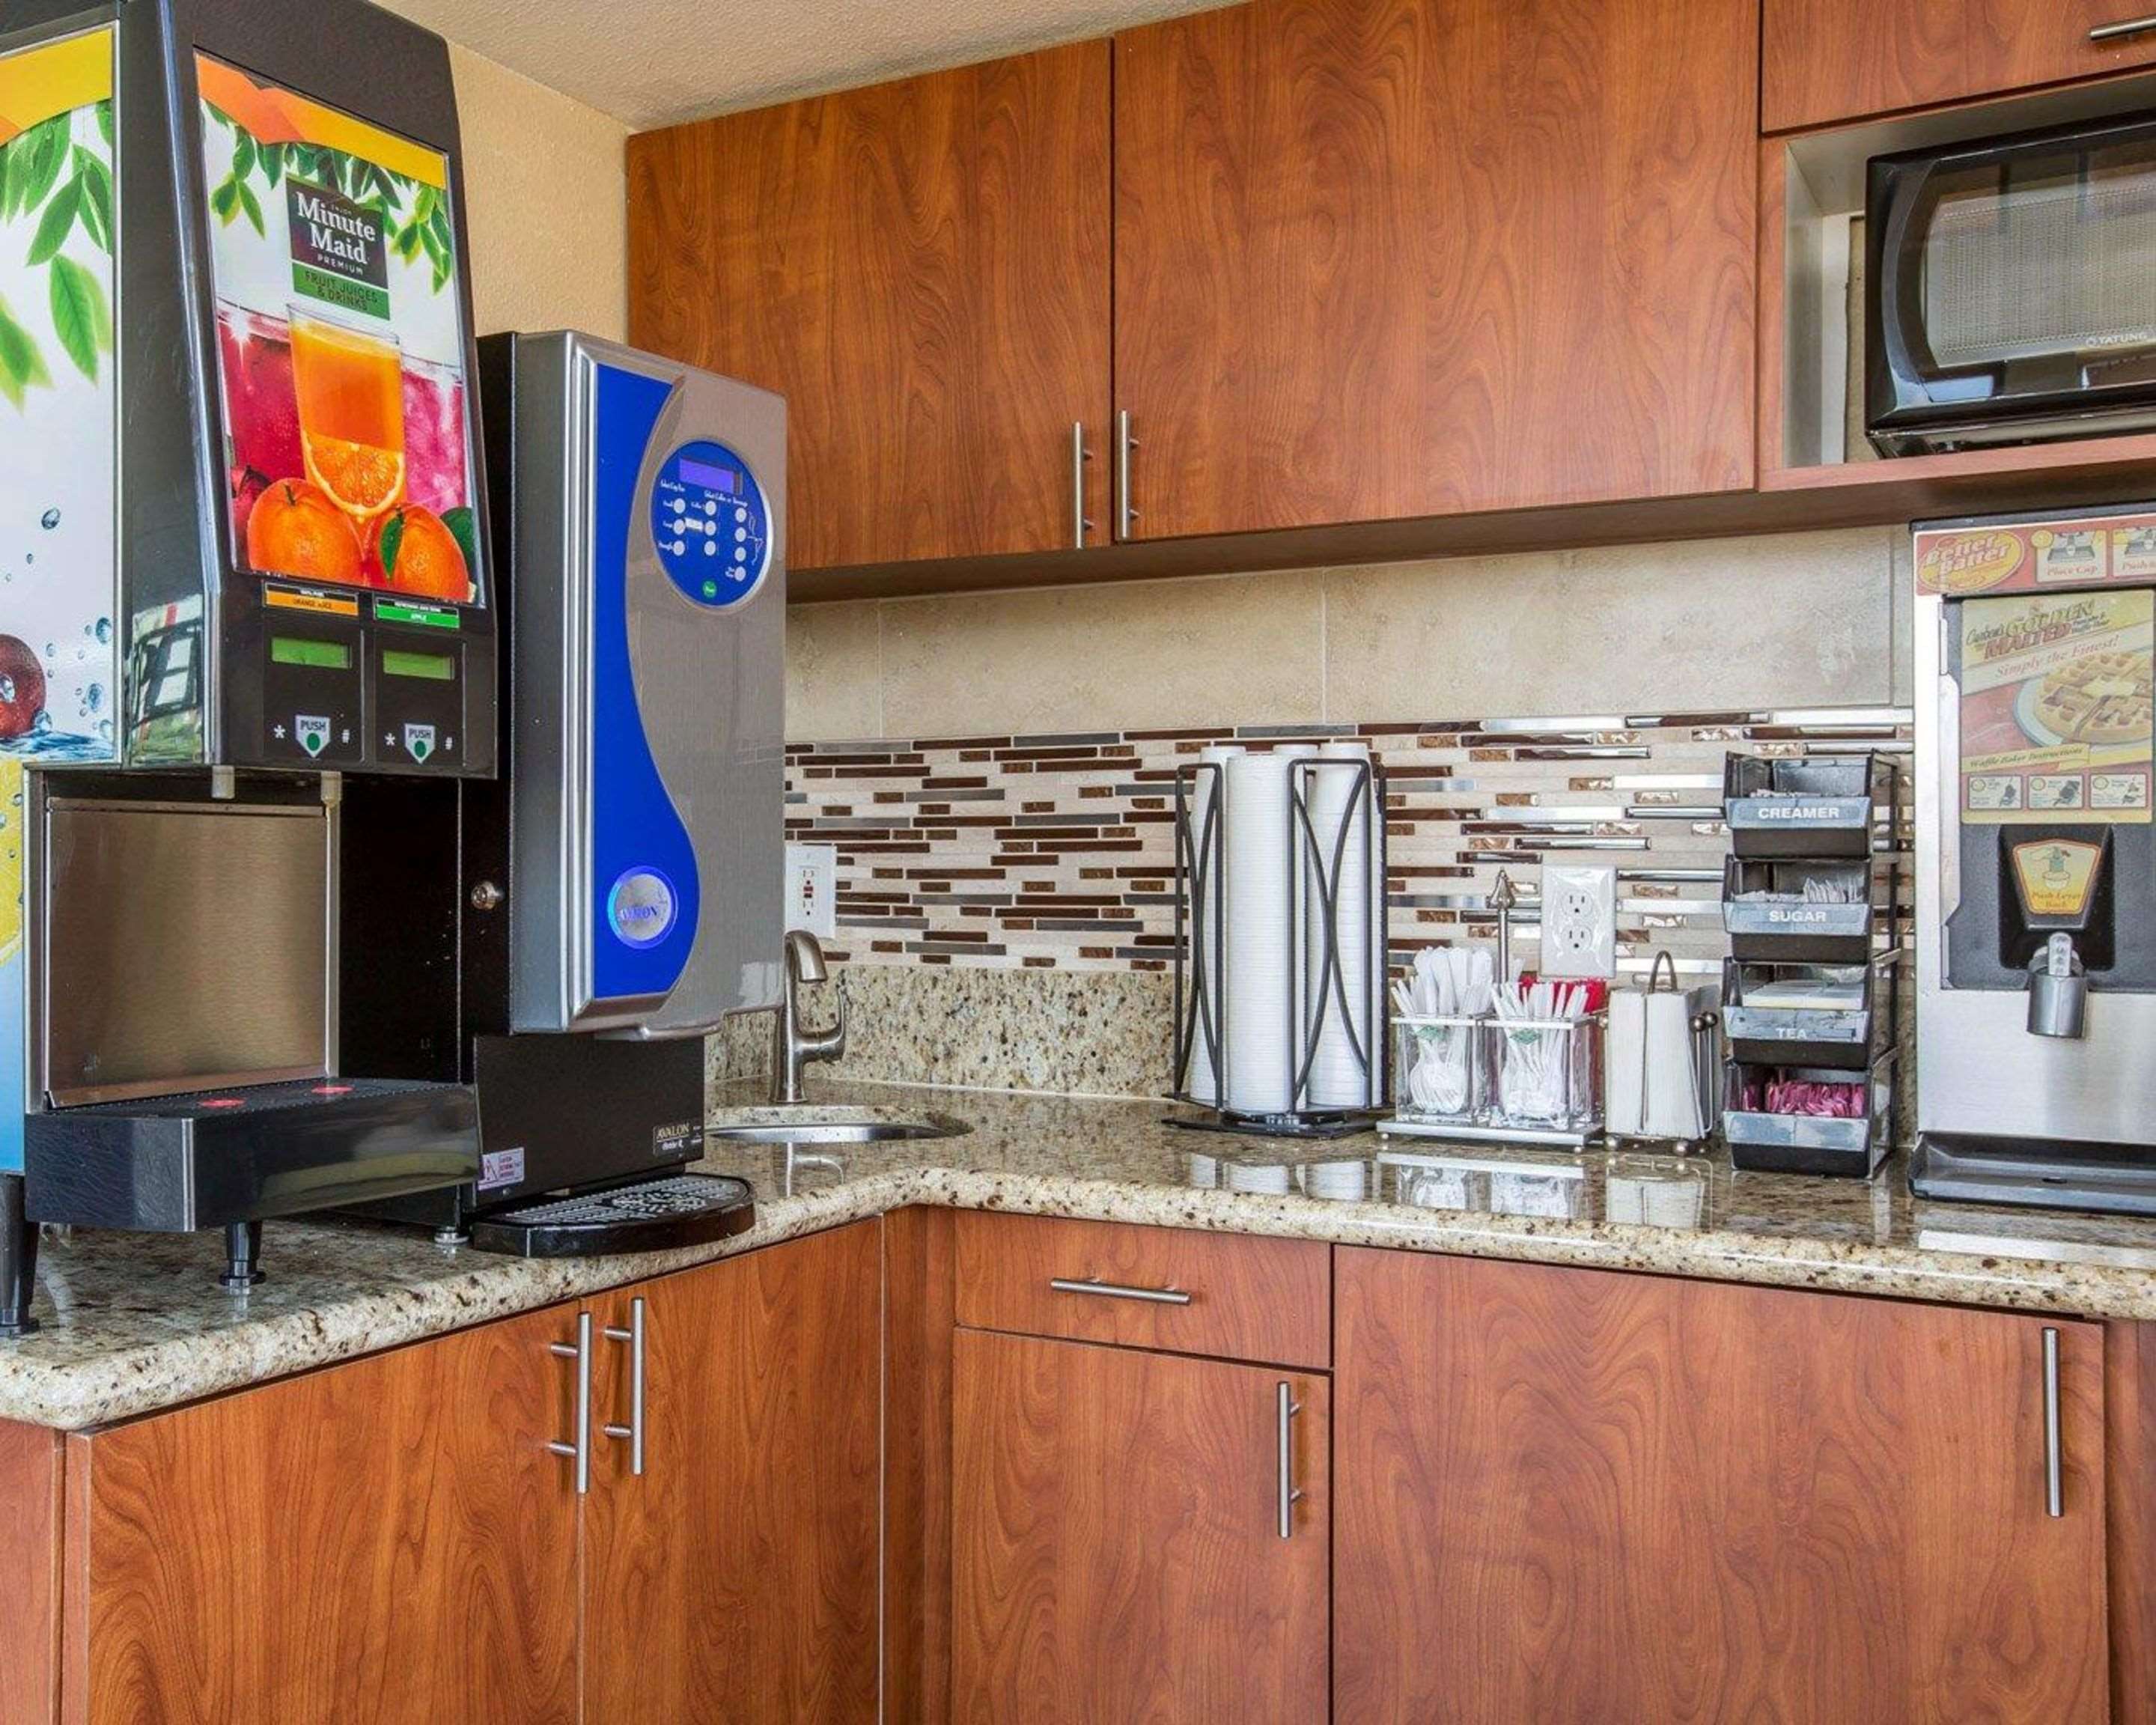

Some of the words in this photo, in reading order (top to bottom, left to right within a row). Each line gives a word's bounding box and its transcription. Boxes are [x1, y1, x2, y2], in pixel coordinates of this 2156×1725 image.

[296, 192, 376, 242] Minute
[310, 222, 368, 264] Maid
[317, 254, 363, 276] PREMIUM
[305, 270, 336, 288] FRUIT
[340, 284, 378, 303] JUICES
[328, 289, 368, 311] DRINKS
[2098, 332, 2148, 345] TATUNG
[300, 719, 326, 731] PUSH
[409, 728, 432, 740] PUSH
[1758, 807, 1839, 819] CREAMER
[1769, 910, 1826, 922] SUGAR
[1776, 1028, 1807, 1039] TEA
